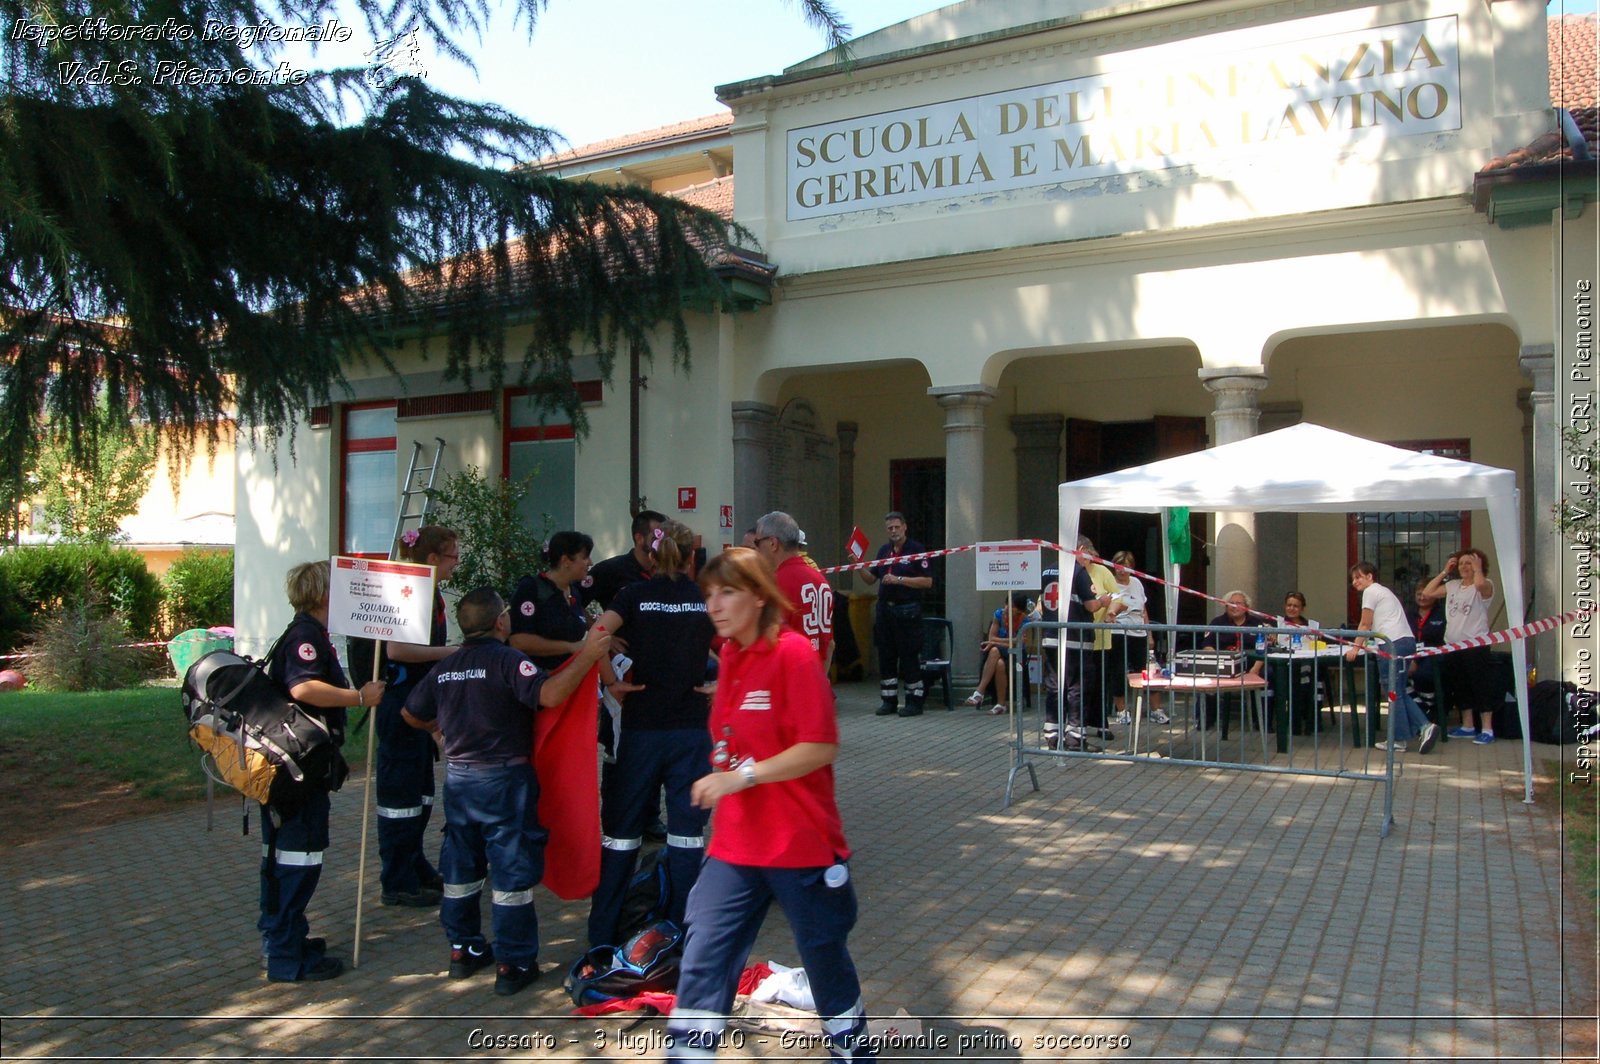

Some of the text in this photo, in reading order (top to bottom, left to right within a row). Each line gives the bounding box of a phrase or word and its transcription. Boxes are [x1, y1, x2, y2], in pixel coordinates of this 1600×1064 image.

[796, 111, 976, 169] SCUOLA
[796, 82, 1449, 209] GEREMIA E MARIA LAVINO
[359, 602, 400, 614] SQUADRA
[640, 602, 660, 612] CROCE
[661, 603, 682, 613] ROSSA
[801, 583, 834, 635] 30
[350, 612, 409, 626] PROVINCIALE
[363, 625, 393, 636] CUNEO
